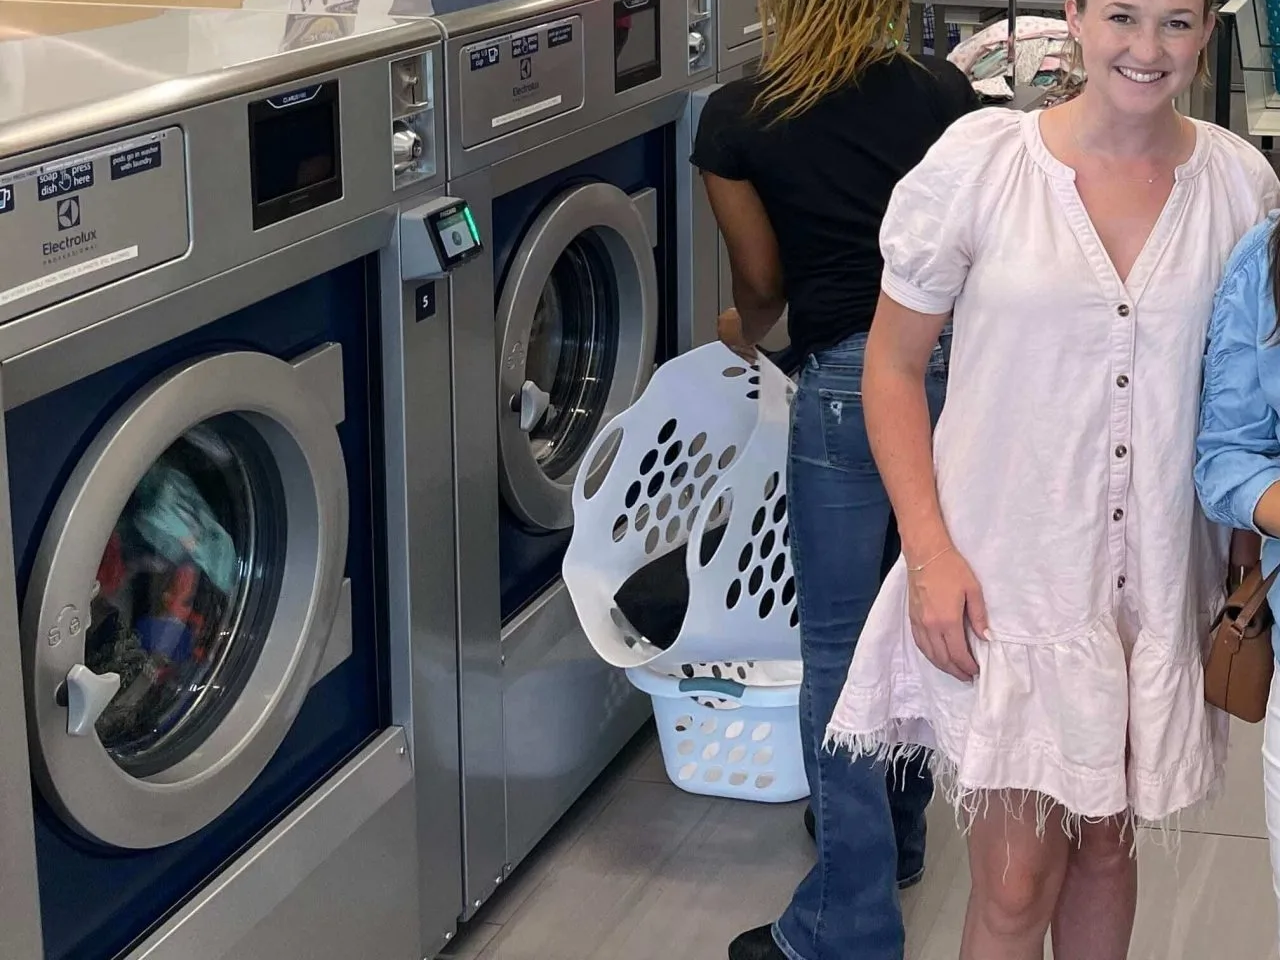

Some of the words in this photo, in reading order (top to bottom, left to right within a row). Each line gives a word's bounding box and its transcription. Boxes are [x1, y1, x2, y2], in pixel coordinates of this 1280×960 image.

[39, 171, 58, 184] soap
[71, 162, 91, 177] press
[41, 183, 58, 196] dish
[73, 174, 91, 187] here
[42, 229, 97, 256] Electrolux
[422, 295, 429, 308] 5
